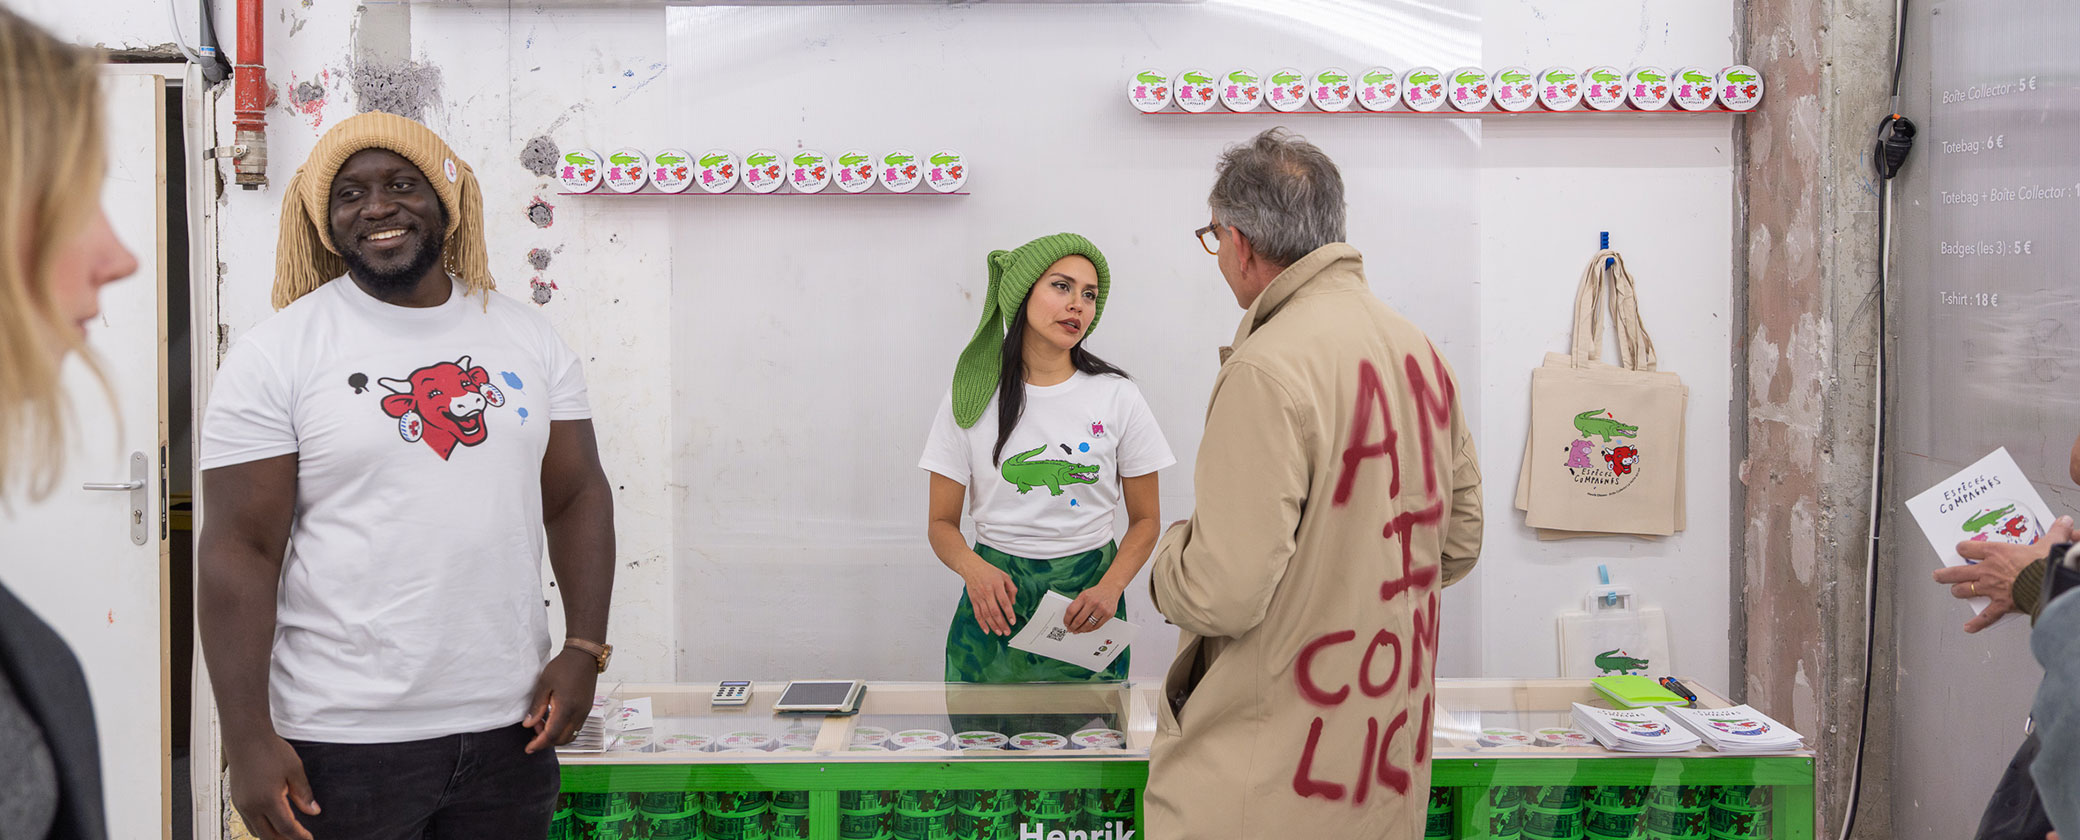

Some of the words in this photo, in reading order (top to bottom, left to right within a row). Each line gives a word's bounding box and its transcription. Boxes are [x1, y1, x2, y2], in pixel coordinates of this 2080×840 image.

[1942, 89, 1966, 104] Boîte
[1967, 83, 2012, 100] Collector
[2019, 78, 2026, 92] 5
[2029, 75, 2037, 90] €
[1942, 139, 1979, 155] Totebag
[1987, 136, 1994, 149] 6
[1996, 135, 2004, 148] €
[1941, 190, 1979, 206] Totebag
[1990, 187, 2016, 202] Boîte
[2018, 184, 2066, 200] Collector
[1941, 240, 1975, 259] Badges
[1977, 240, 1994, 257] (les
[1996, 240, 2006, 257] 3)
[2014, 240, 2021, 254] 5
[2024, 240, 2032, 254] €
[1940, 290, 1968, 306] T-shirt
[1975, 293, 1989, 307] 18
[1991, 293, 1998, 307] €
